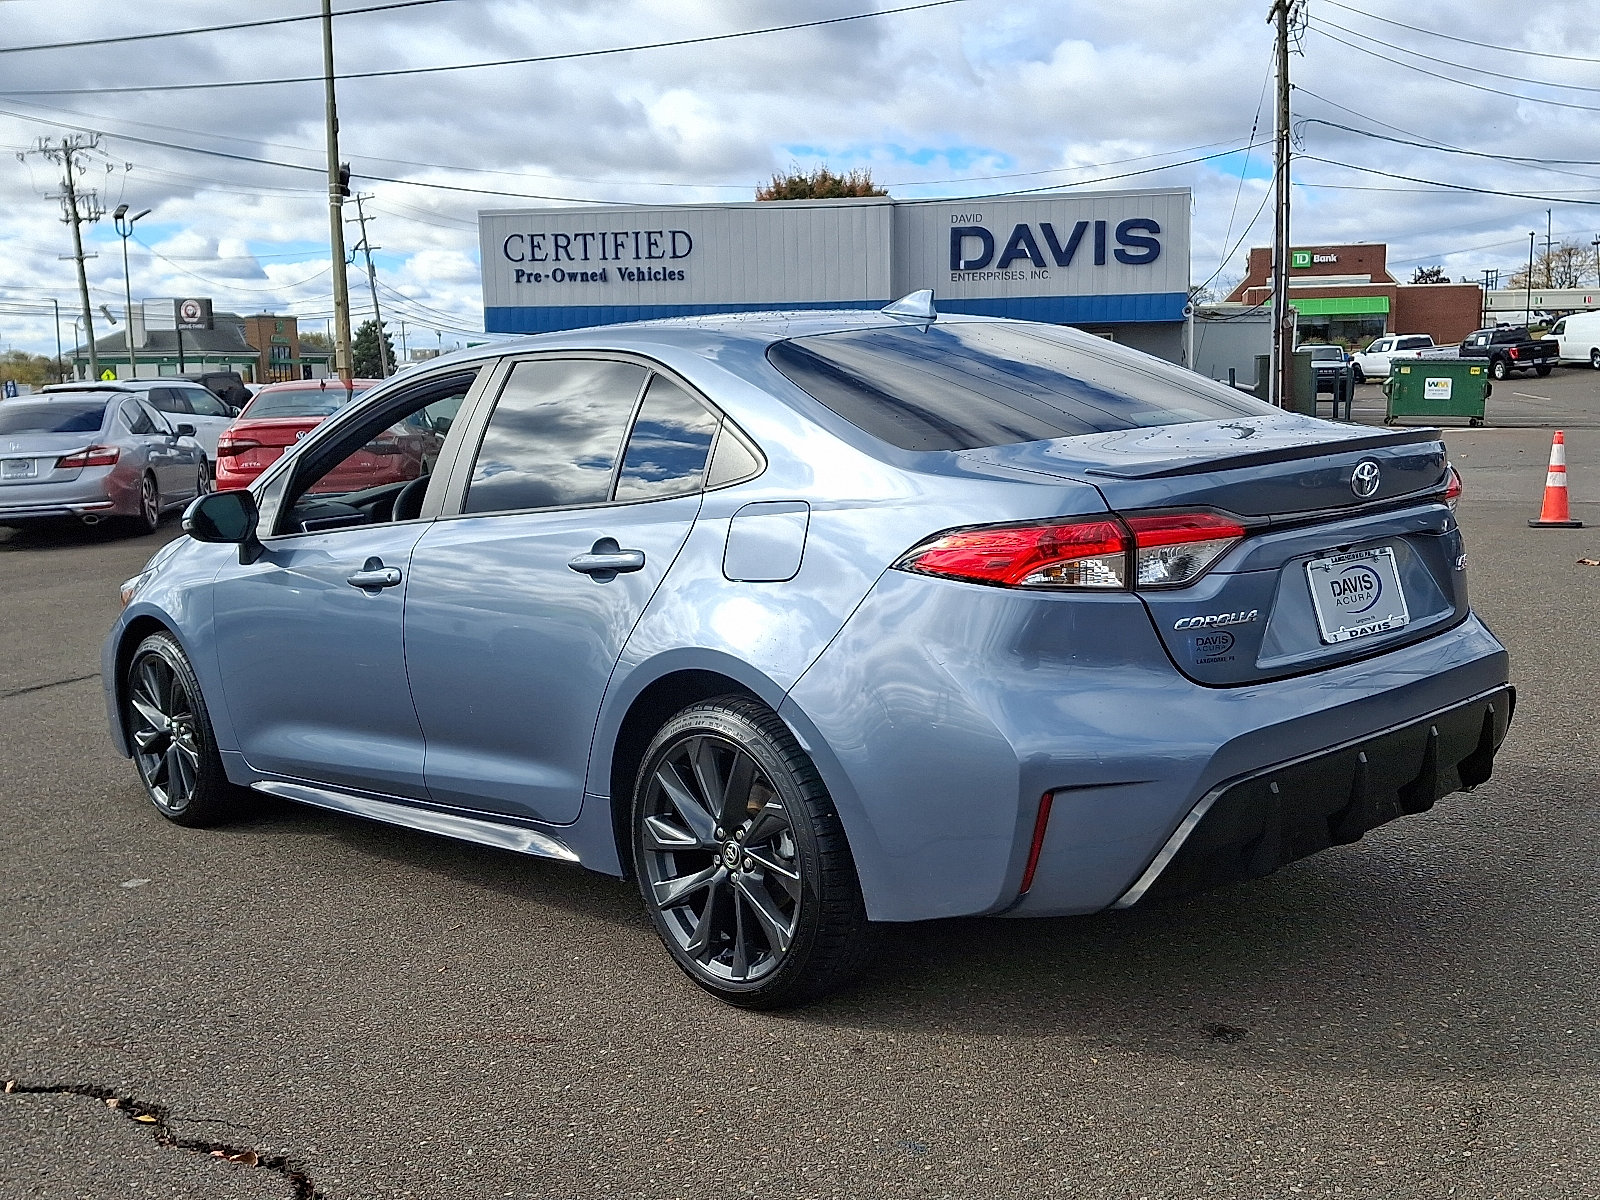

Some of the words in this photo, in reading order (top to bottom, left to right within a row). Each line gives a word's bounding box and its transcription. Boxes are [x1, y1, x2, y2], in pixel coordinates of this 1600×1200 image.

[950, 213, 983, 224] DAVID
[503, 230, 693, 262] CERTIFIED
[950, 218, 1161, 271] DAVIS
[1293, 253, 1309, 265] TD
[1313, 253, 1337, 263] Bank
[514, 267, 608, 283] Pre-Owned
[617, 266, 685, 281] Vehicles
[951, 271, 1028, 282] ENTERPRISES,
[1030, 270, 1052, 281] INC.
[1330, 573, 1374, 598] DAVIS
[1336, 592, 1373, 607] ACURA
[1174, 609, 1258, 631] COROLLA
[1349, 621, 1391, 638] DAVIS
[1195, 635, 1229, 646] DAVIS
